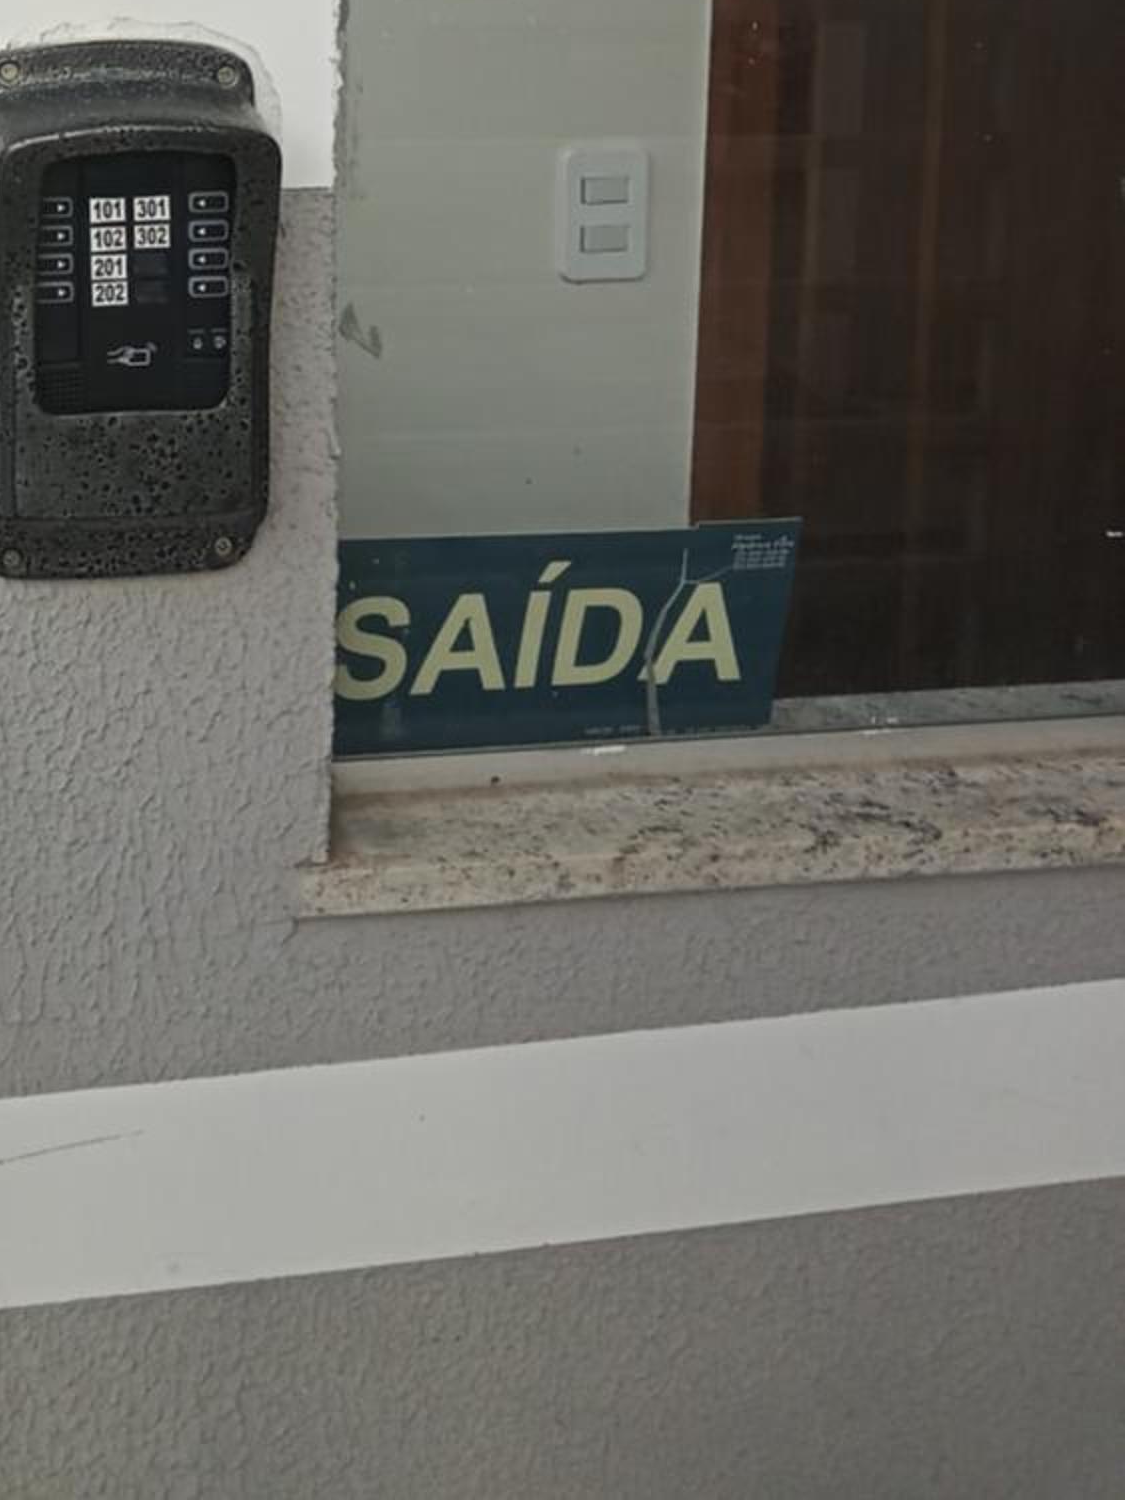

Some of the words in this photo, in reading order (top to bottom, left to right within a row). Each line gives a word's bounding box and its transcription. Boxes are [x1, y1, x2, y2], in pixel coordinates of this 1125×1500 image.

[94, 201, 122, 219] 101
[137, 199, 166, 218] 301
[94, 229, 124, 248] 102
[138, 227, 166, 245] 302
[95, 257, 123, 277] 201
[95, 284, 125, 303] 202
[334, 561, 741, 700] SAÍDA
